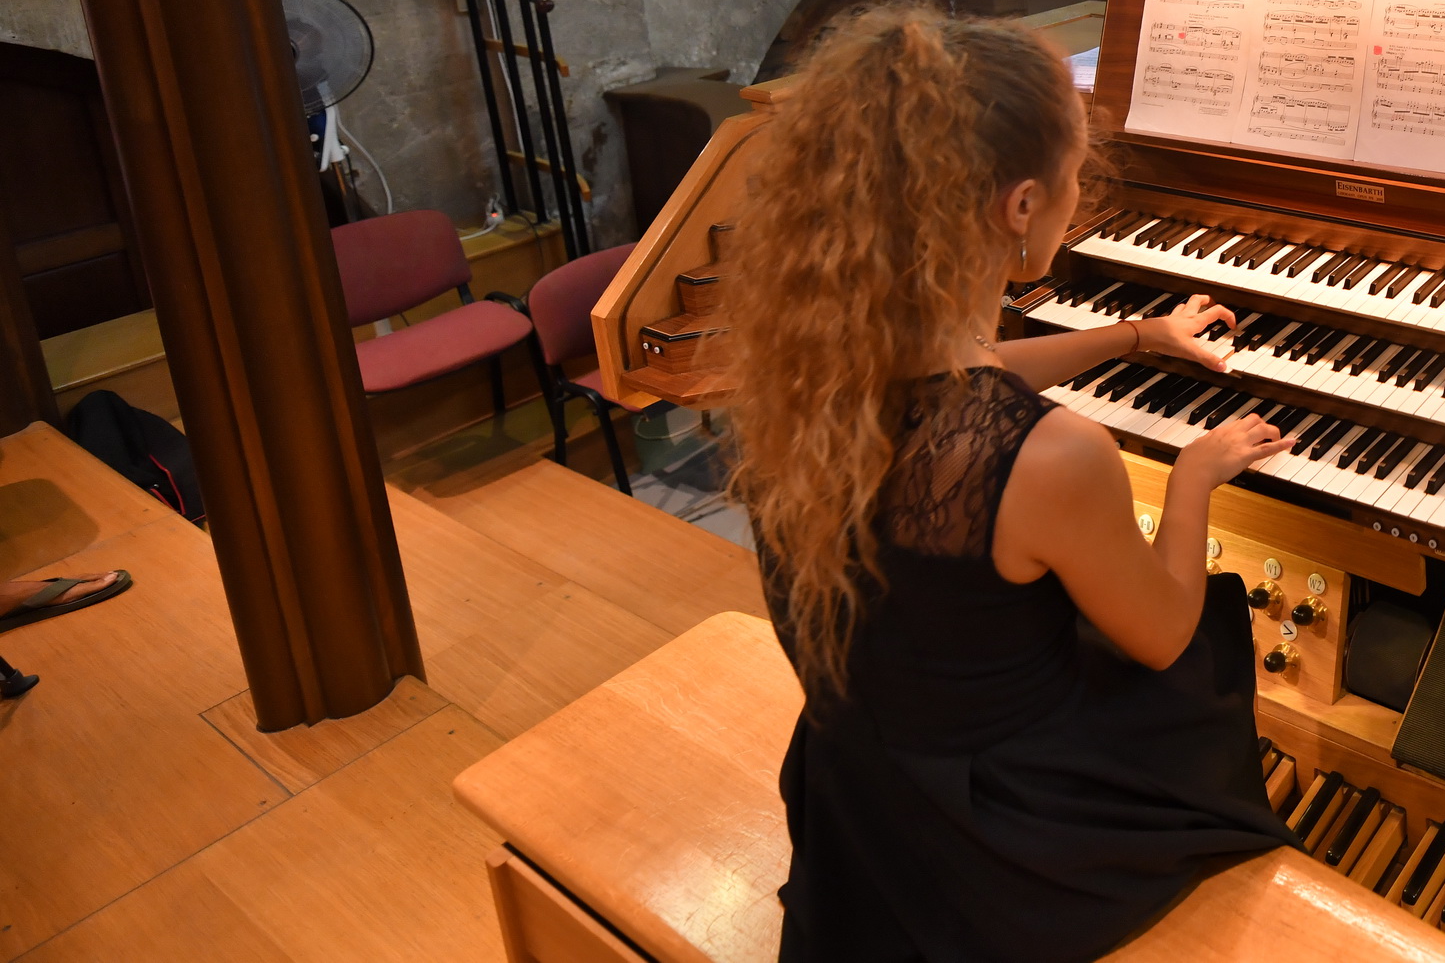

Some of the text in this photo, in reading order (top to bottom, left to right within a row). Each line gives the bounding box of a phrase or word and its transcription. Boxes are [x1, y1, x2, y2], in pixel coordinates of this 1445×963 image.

[1338, 182, 1383, 196] EISENBARTH
[1265, 563, 1277, 575] W1
[1309, 577, 1322, 591] W2
